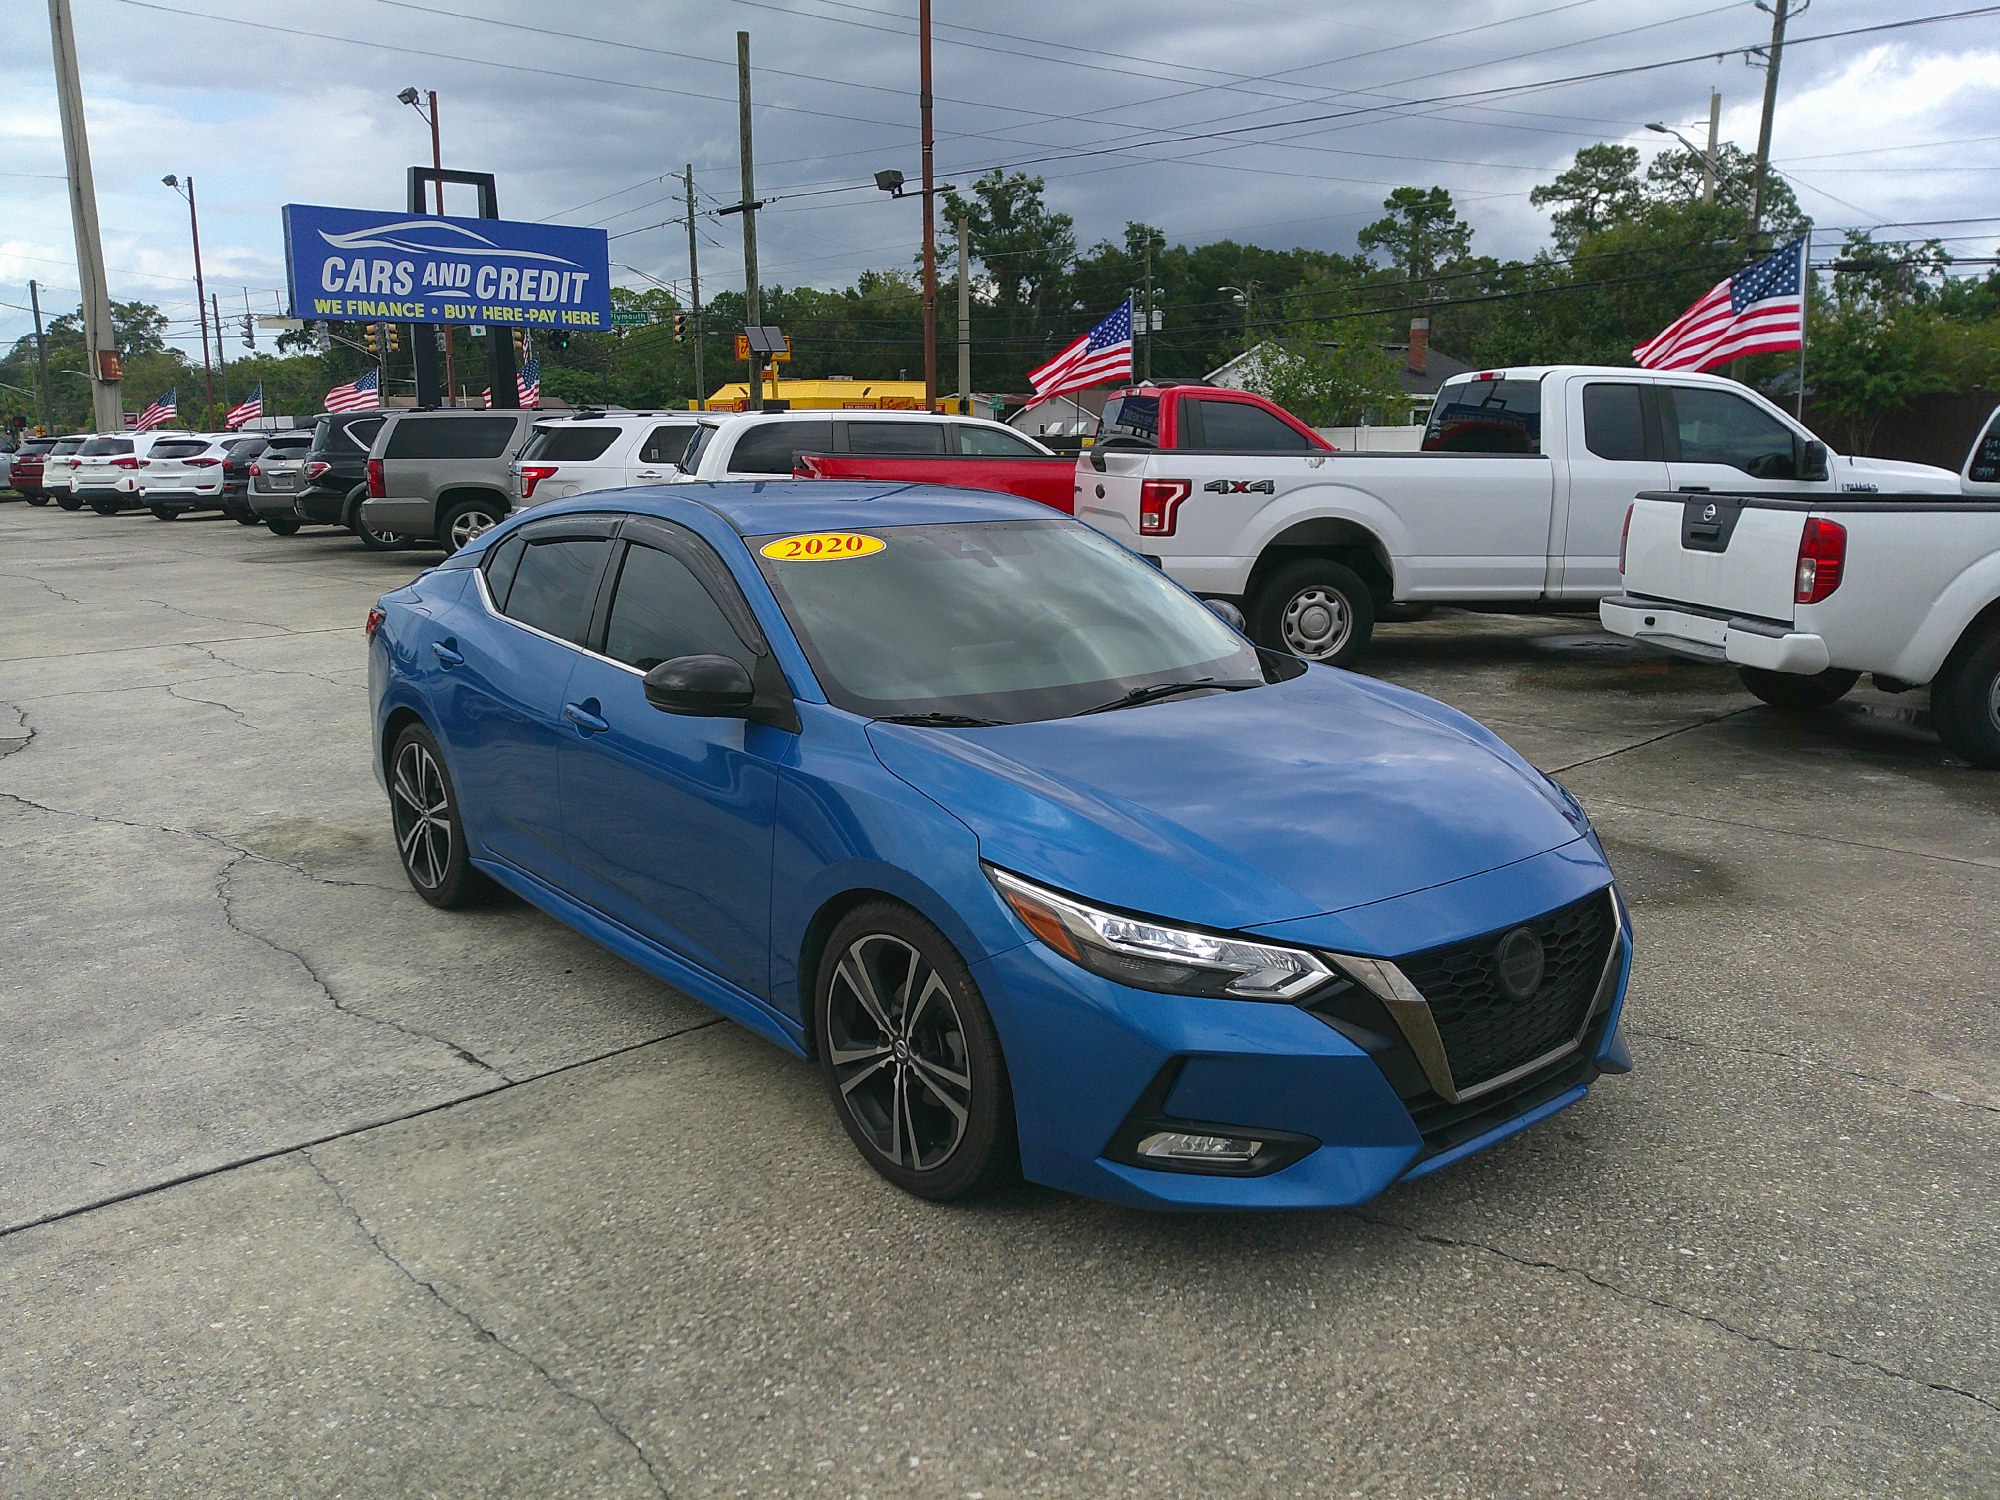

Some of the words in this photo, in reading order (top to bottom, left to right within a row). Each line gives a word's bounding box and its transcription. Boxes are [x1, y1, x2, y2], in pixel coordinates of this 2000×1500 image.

[321, 256, 415, 296] CARS
[422, 261, 471, 287] AND
[475, 265, 590, 304] CREDIT
[314, 298, 343, 315] WE
[346, 300, 425, 318] FINANCE
[444, 304, 478, 319] BUY
[482, 306, 557, 323] HERE-PAY
[561, 310, 600, 325] HERE
[785, 536, 863, 557] 2020
